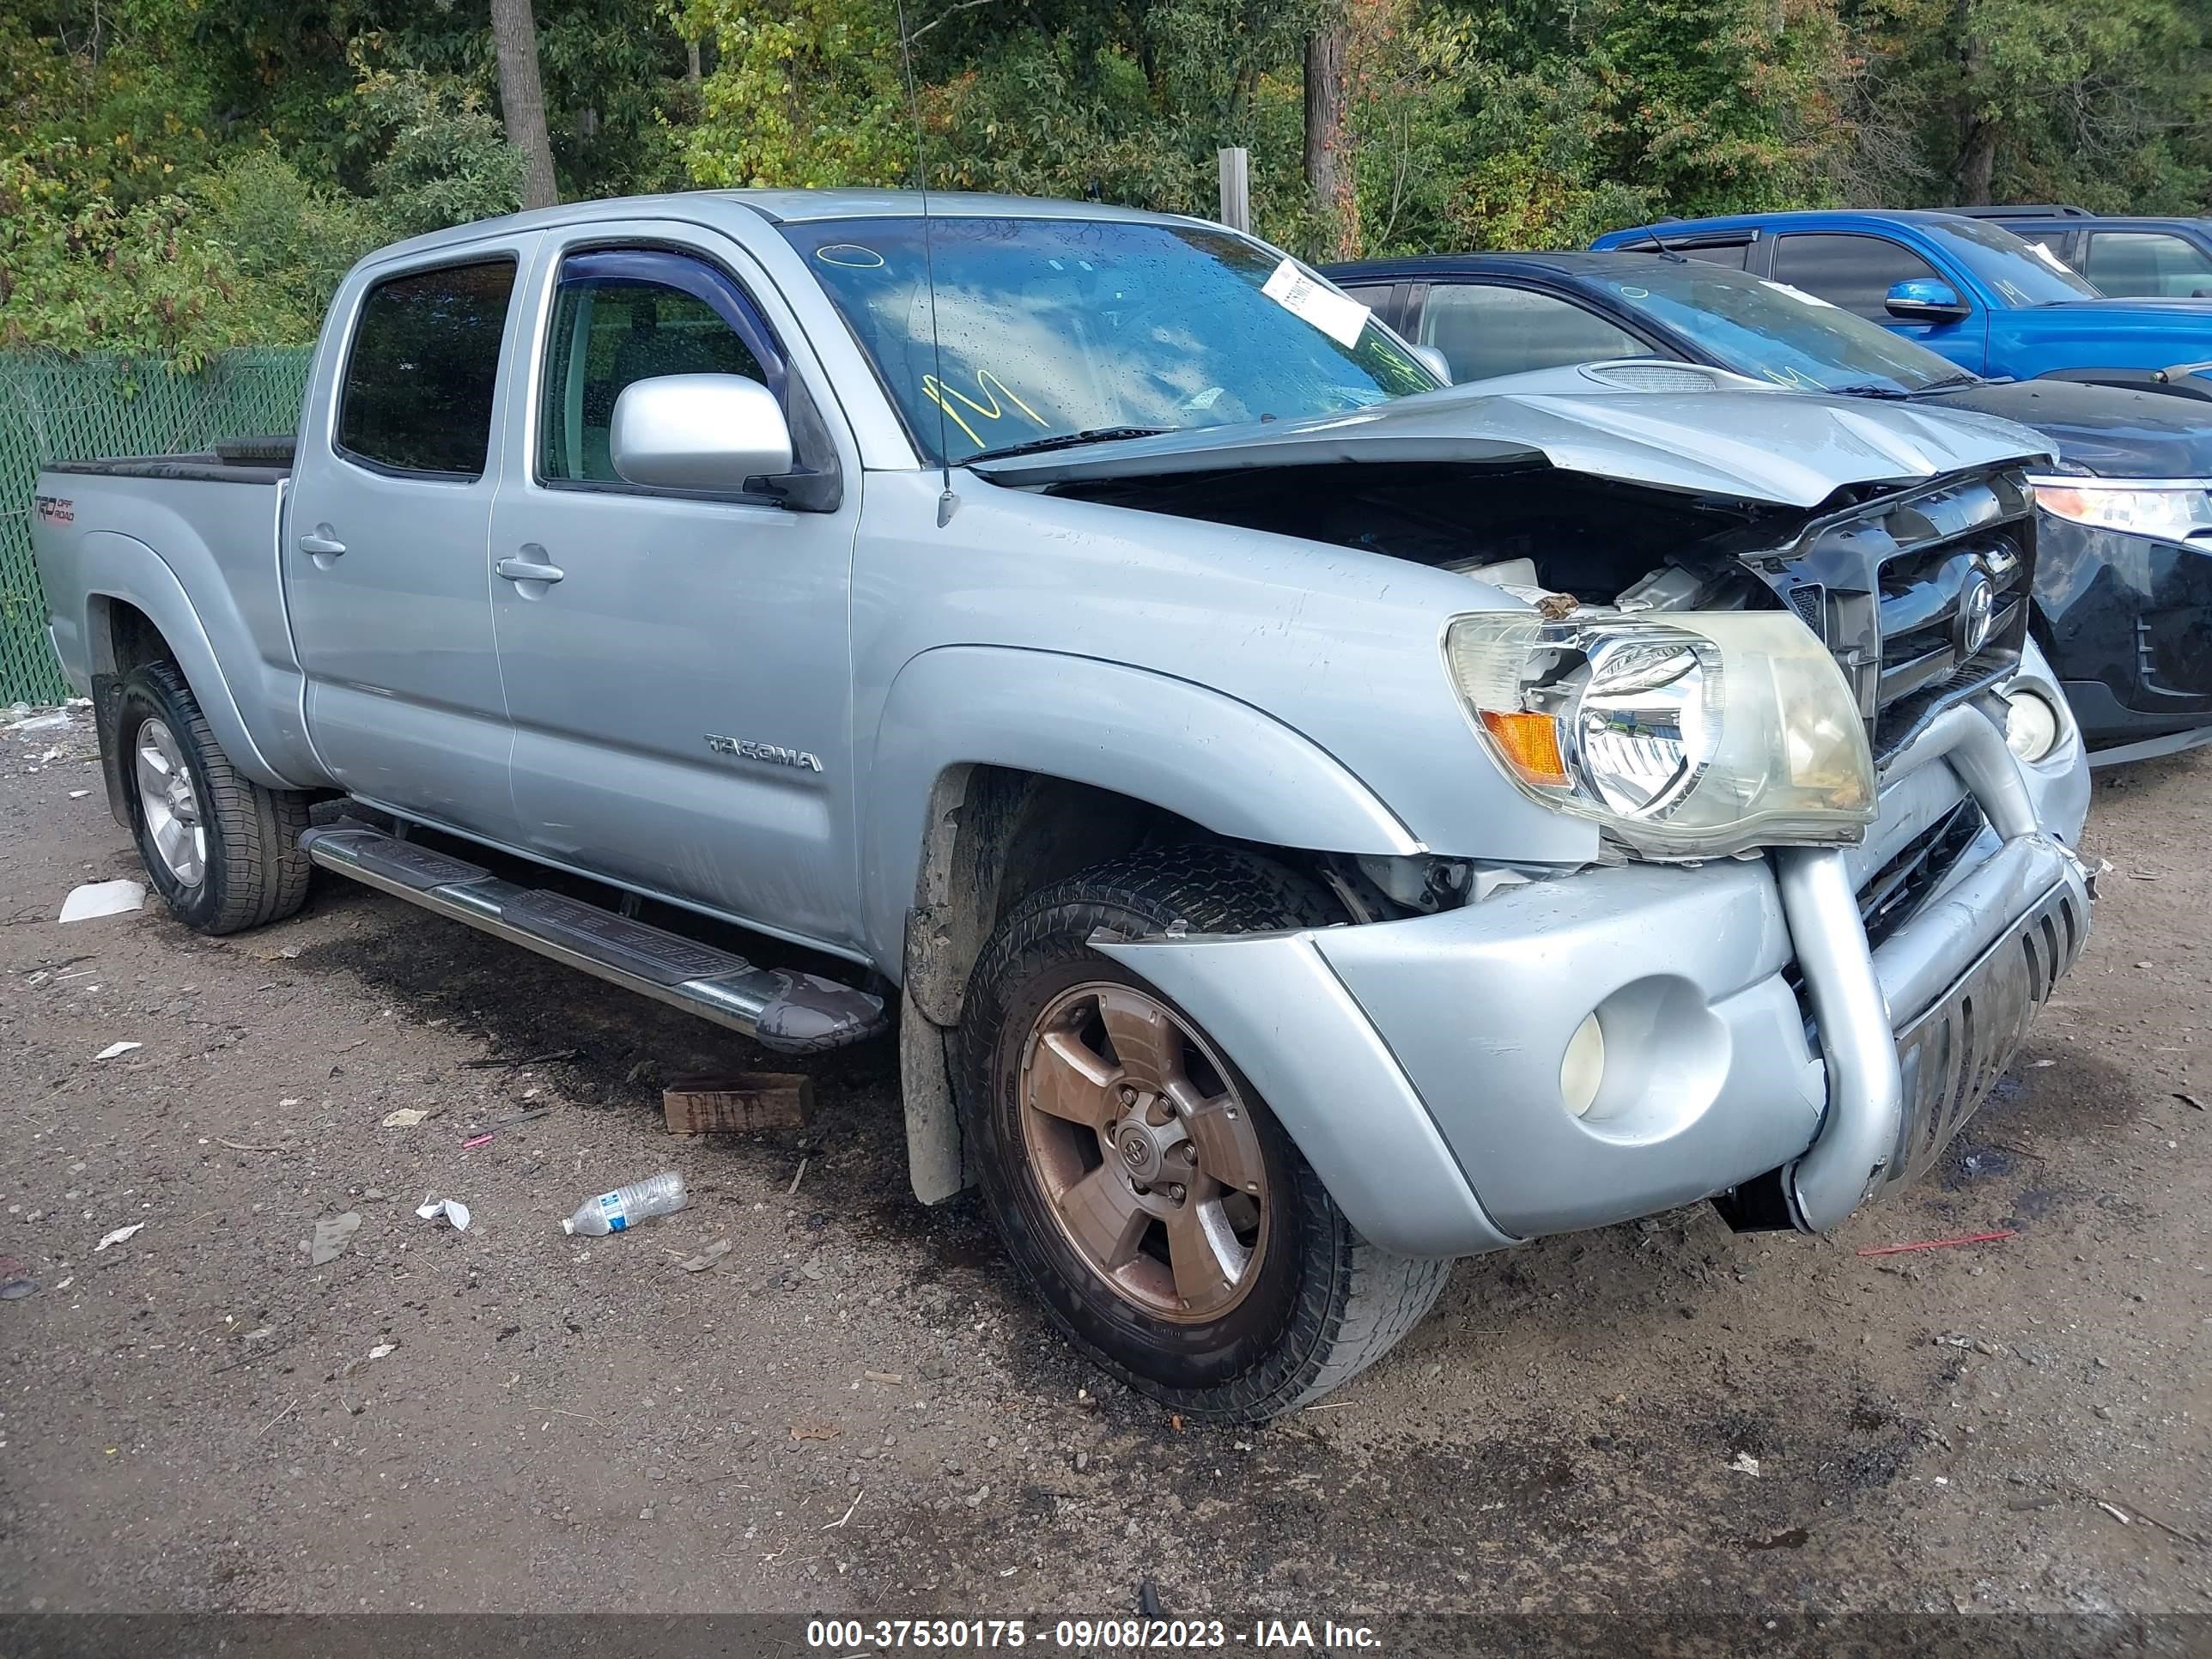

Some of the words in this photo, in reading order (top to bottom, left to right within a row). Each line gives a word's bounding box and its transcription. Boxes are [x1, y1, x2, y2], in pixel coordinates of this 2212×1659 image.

[34, 495, 57, 520] TRD
[57, 499, 74, 508] OFF
[55, 510, 75, 521] ROAD
[704, 732, 824, 774] TACOMA
